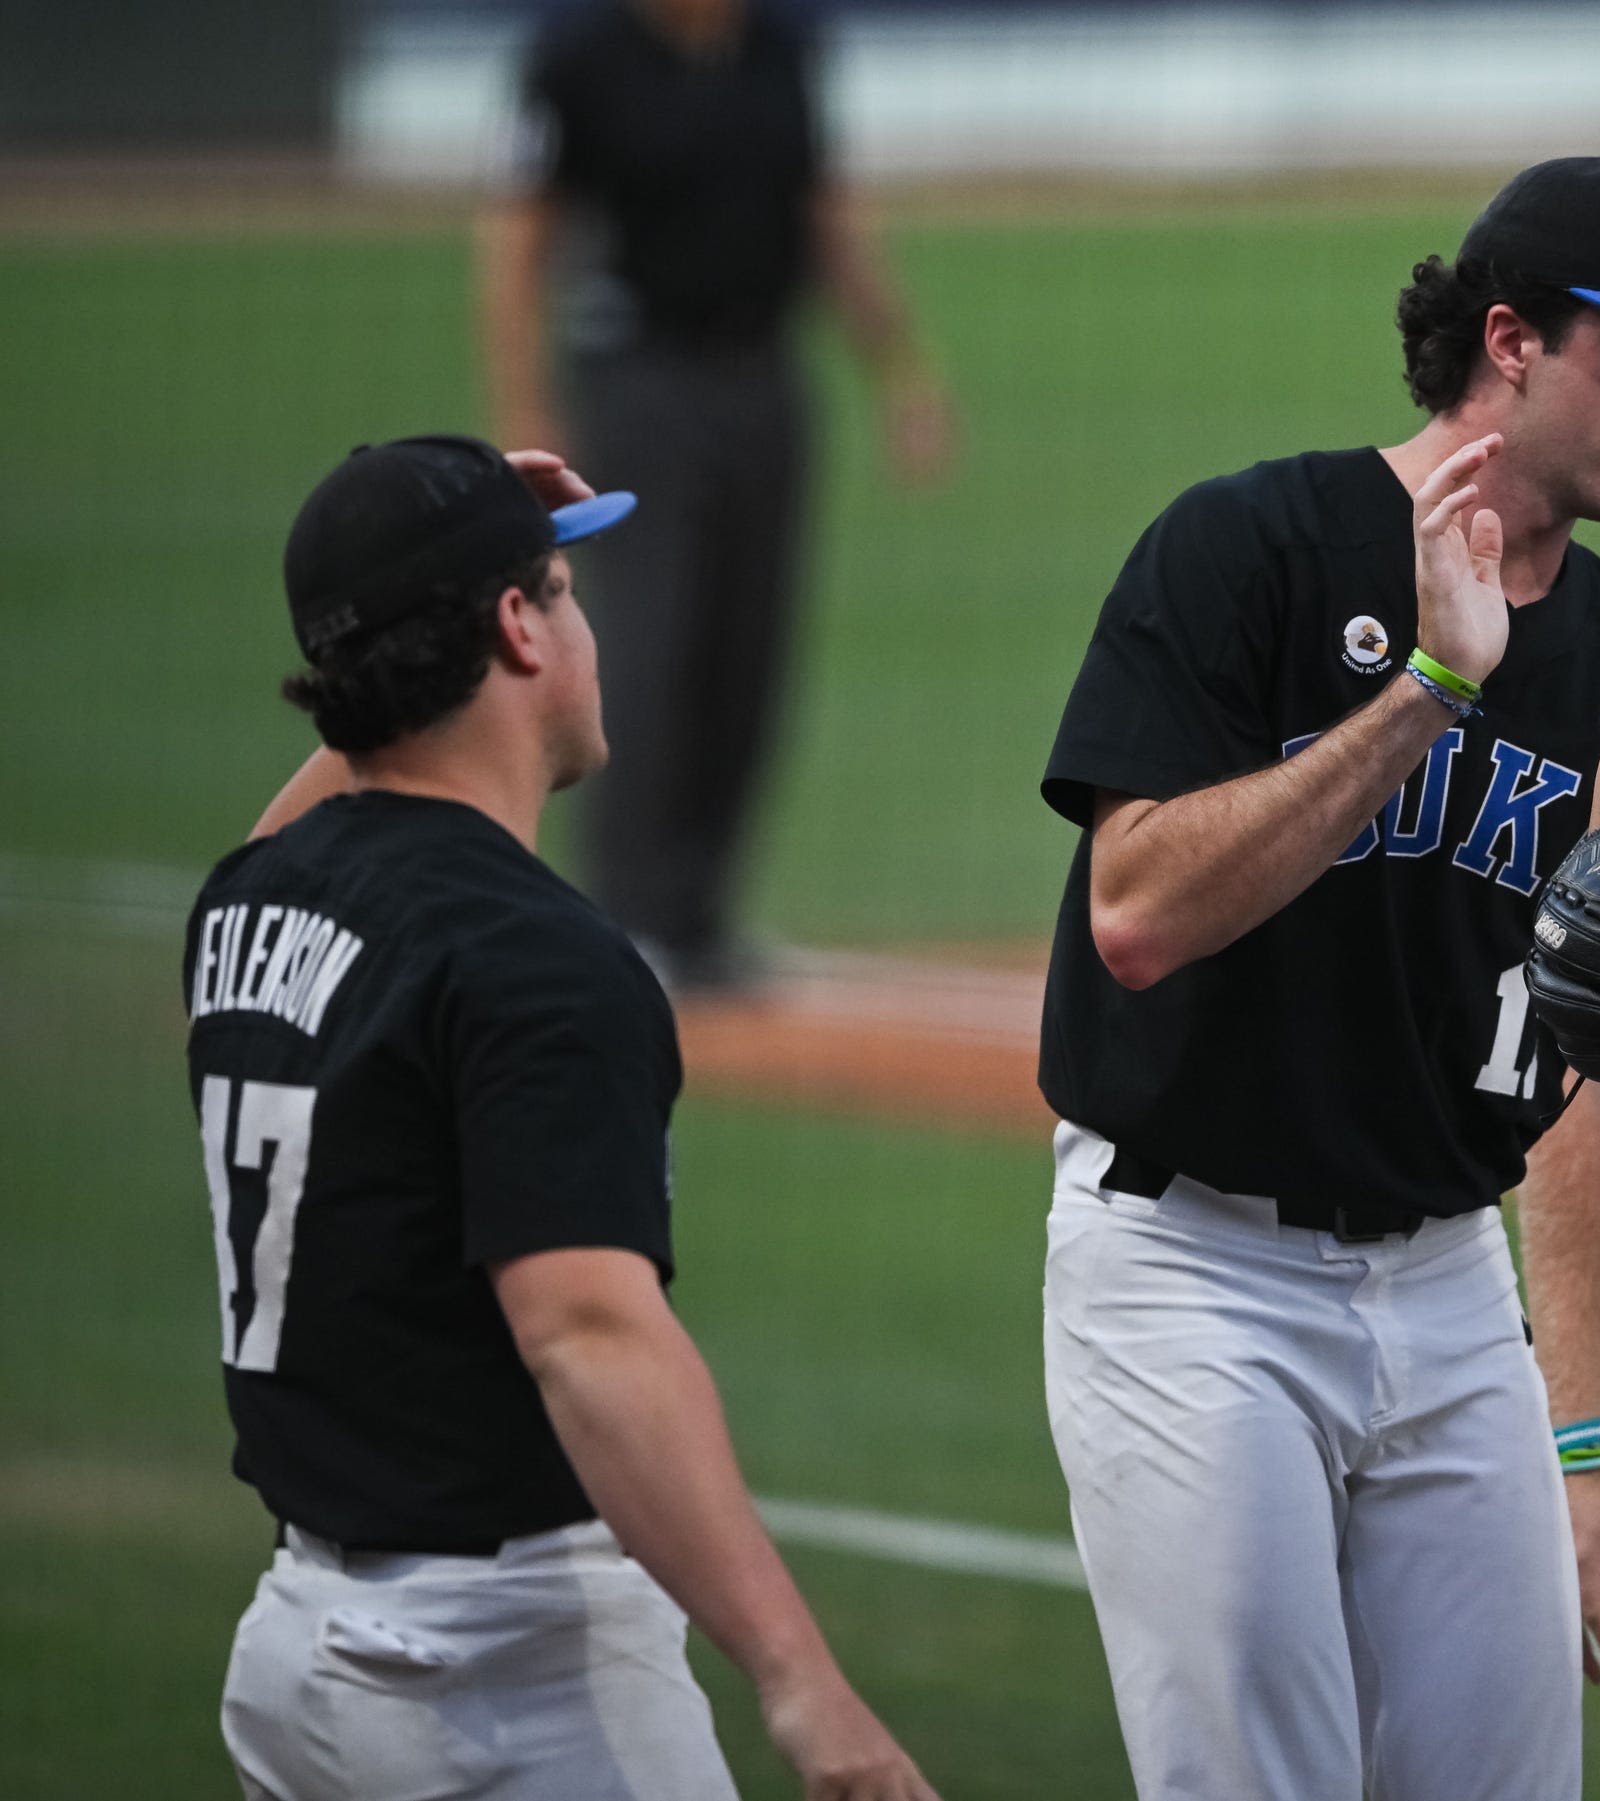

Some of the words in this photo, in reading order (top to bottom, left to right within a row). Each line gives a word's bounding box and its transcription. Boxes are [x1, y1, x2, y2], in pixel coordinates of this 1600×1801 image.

[1341, 652, 1364, 673] United
[1365, 666, 1376, 674] As
[1376, 658, 1392, 671] One
[189, 903, 364, 1037] EILENSON
[1474, 962, 1538, 1100] 1
[201, 1073, 318, 1373] 17
